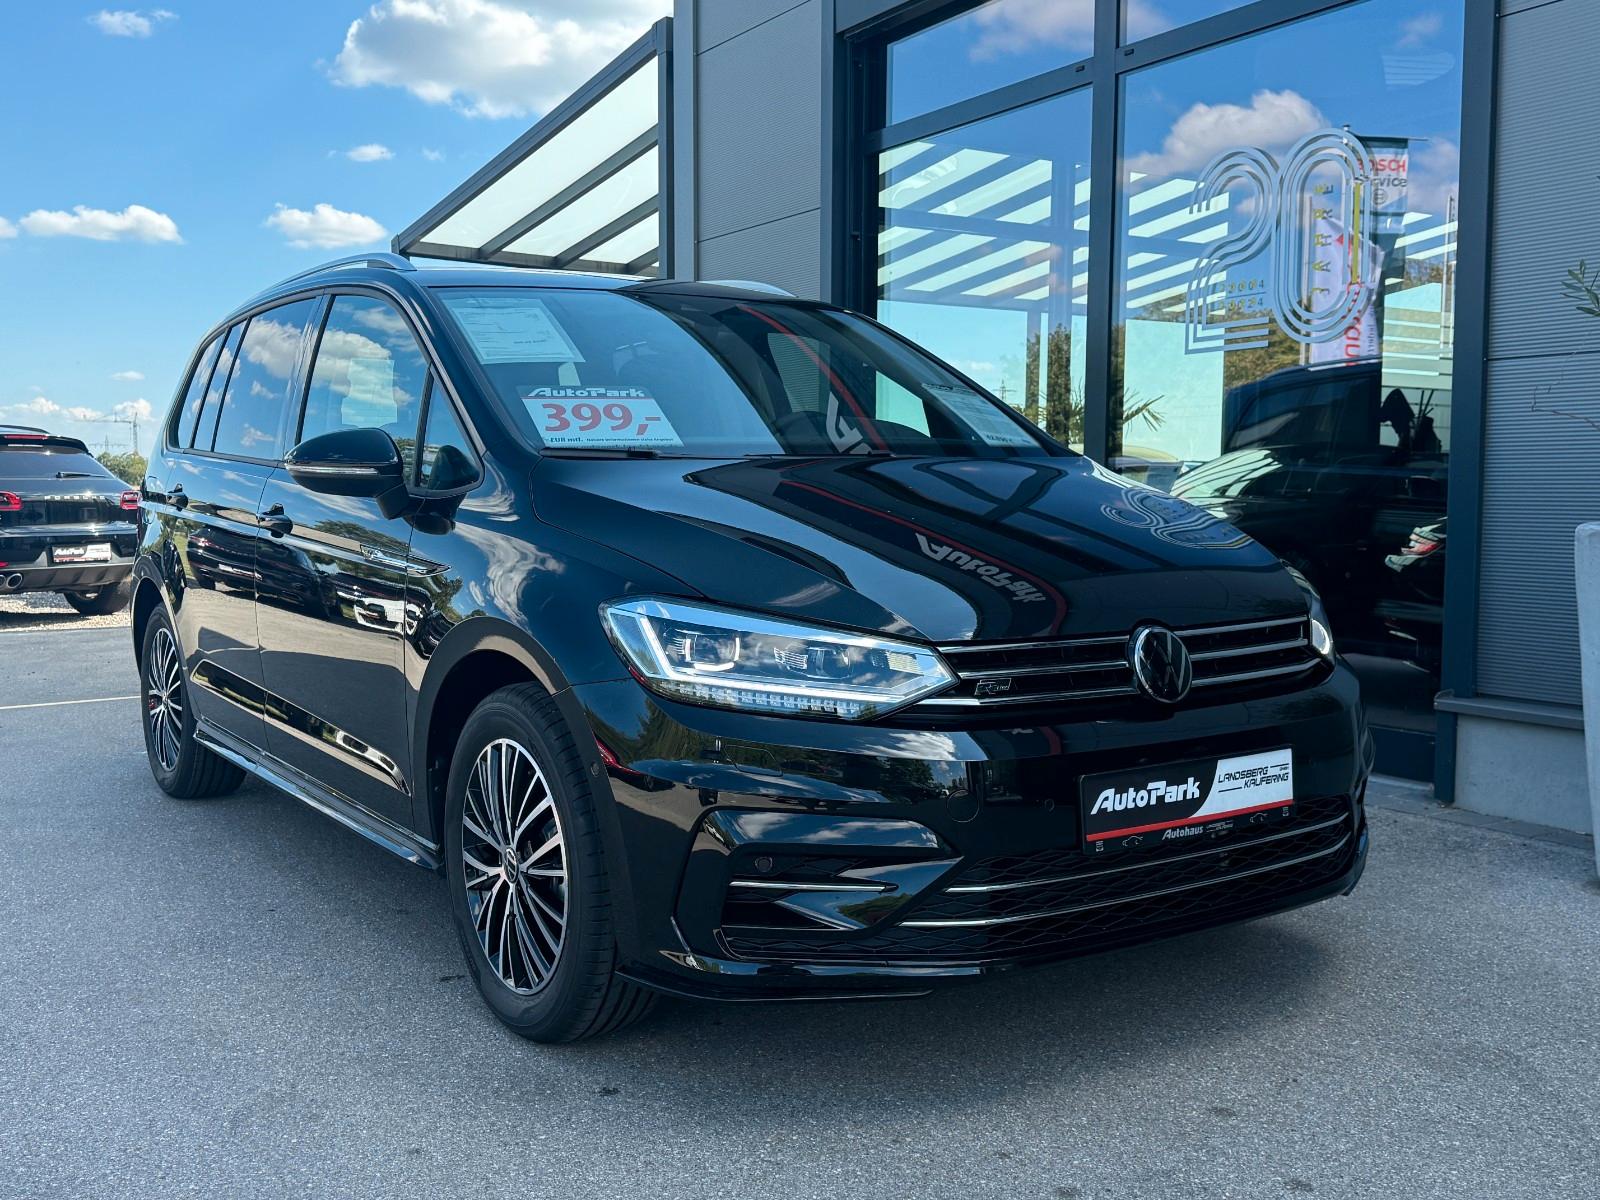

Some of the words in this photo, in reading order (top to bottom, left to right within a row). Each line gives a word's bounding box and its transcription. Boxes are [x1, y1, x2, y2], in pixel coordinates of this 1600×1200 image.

[527, 387, 645, 398] AutoPark
[542, 403, 661, 436] 399,-
[1218, 766, 1269, 783] LANDSBERG
[1244, 772, 1290, 789] KAUFERING
[1090, 777, 1201, 815] AutoPark
[1162, 825, 1204, 840] Autohaus
